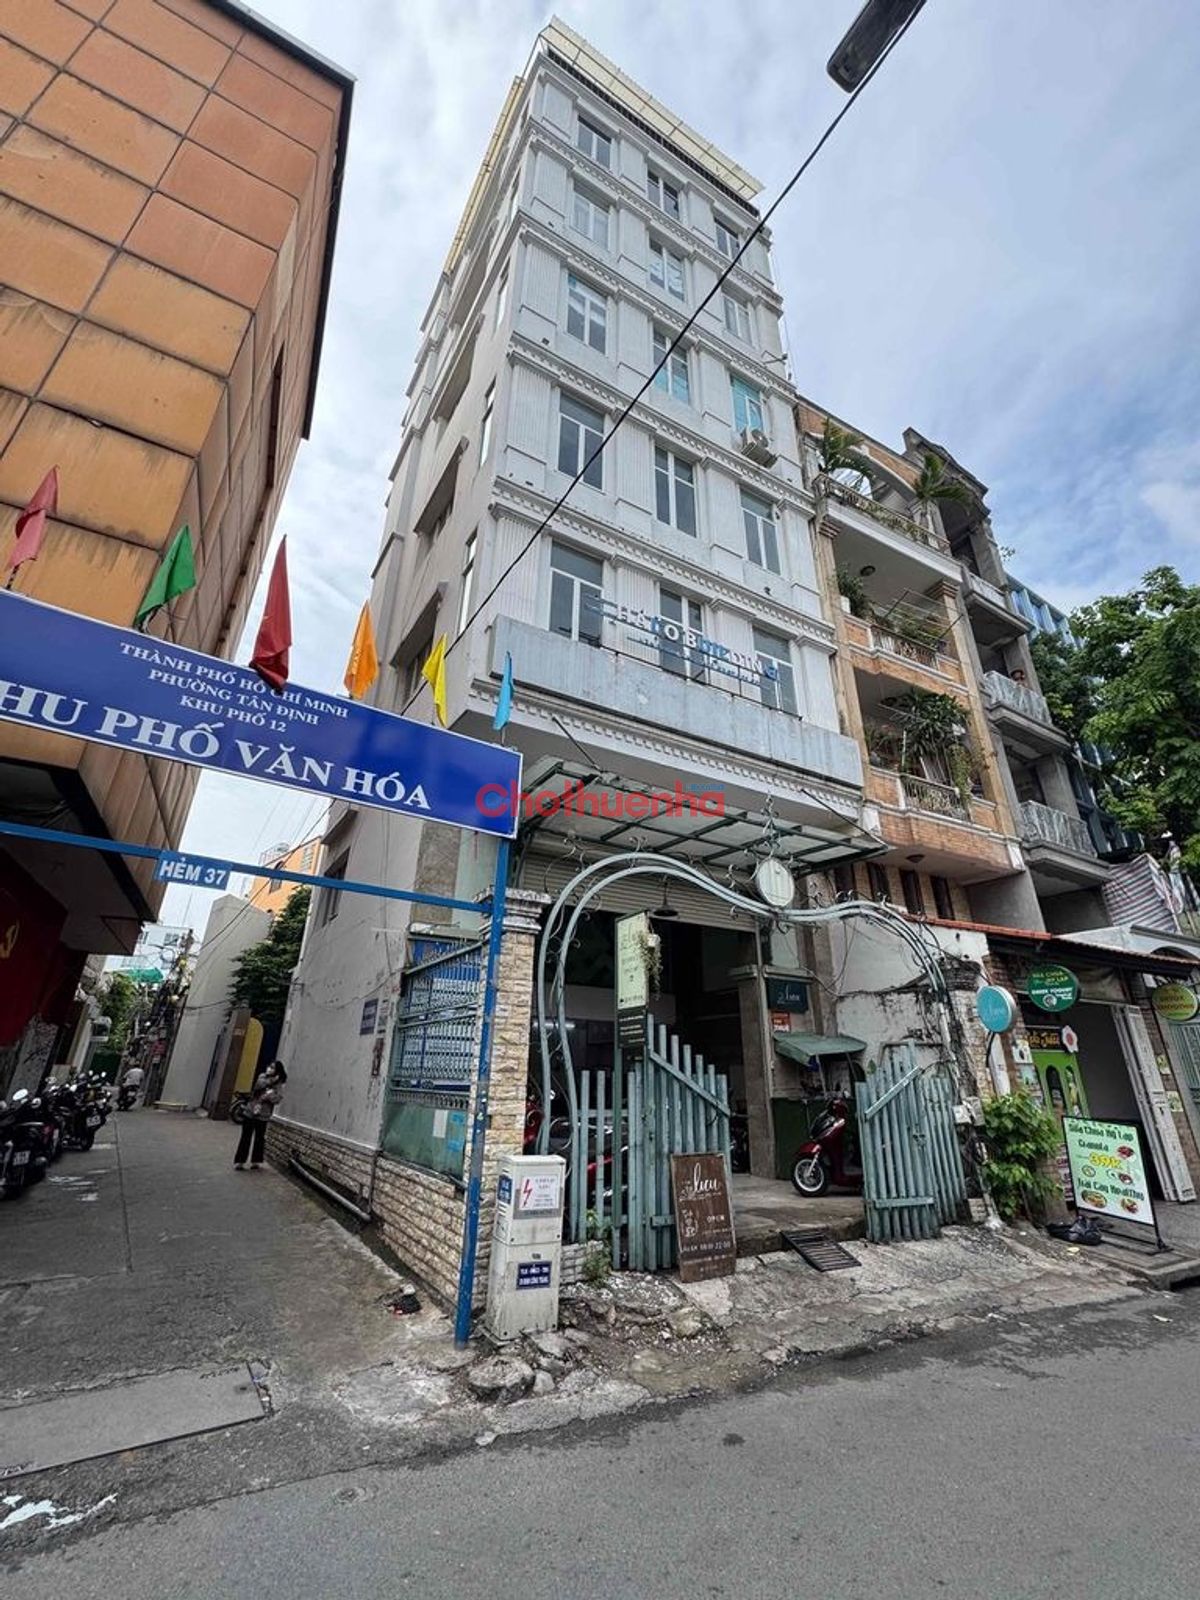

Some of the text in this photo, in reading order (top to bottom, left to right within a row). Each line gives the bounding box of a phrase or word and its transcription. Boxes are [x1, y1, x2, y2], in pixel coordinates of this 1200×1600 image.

[120, 642, 191, 673] THÀNH
[197, 665, 236, 684] PHỐ
[305, 699, 350, 718] MINH
[148, 668, 320, 725] PHƯỜNG TÂN ĐỊNH
[180, 695, 287, 733] KHU PHỐ 12
[95, 706, 224, 758] PHỐ
[235, 739, 335, 787] VĂN
[341, 766, 432, 810] HÓA
[204, 868, 226, 885] 37
